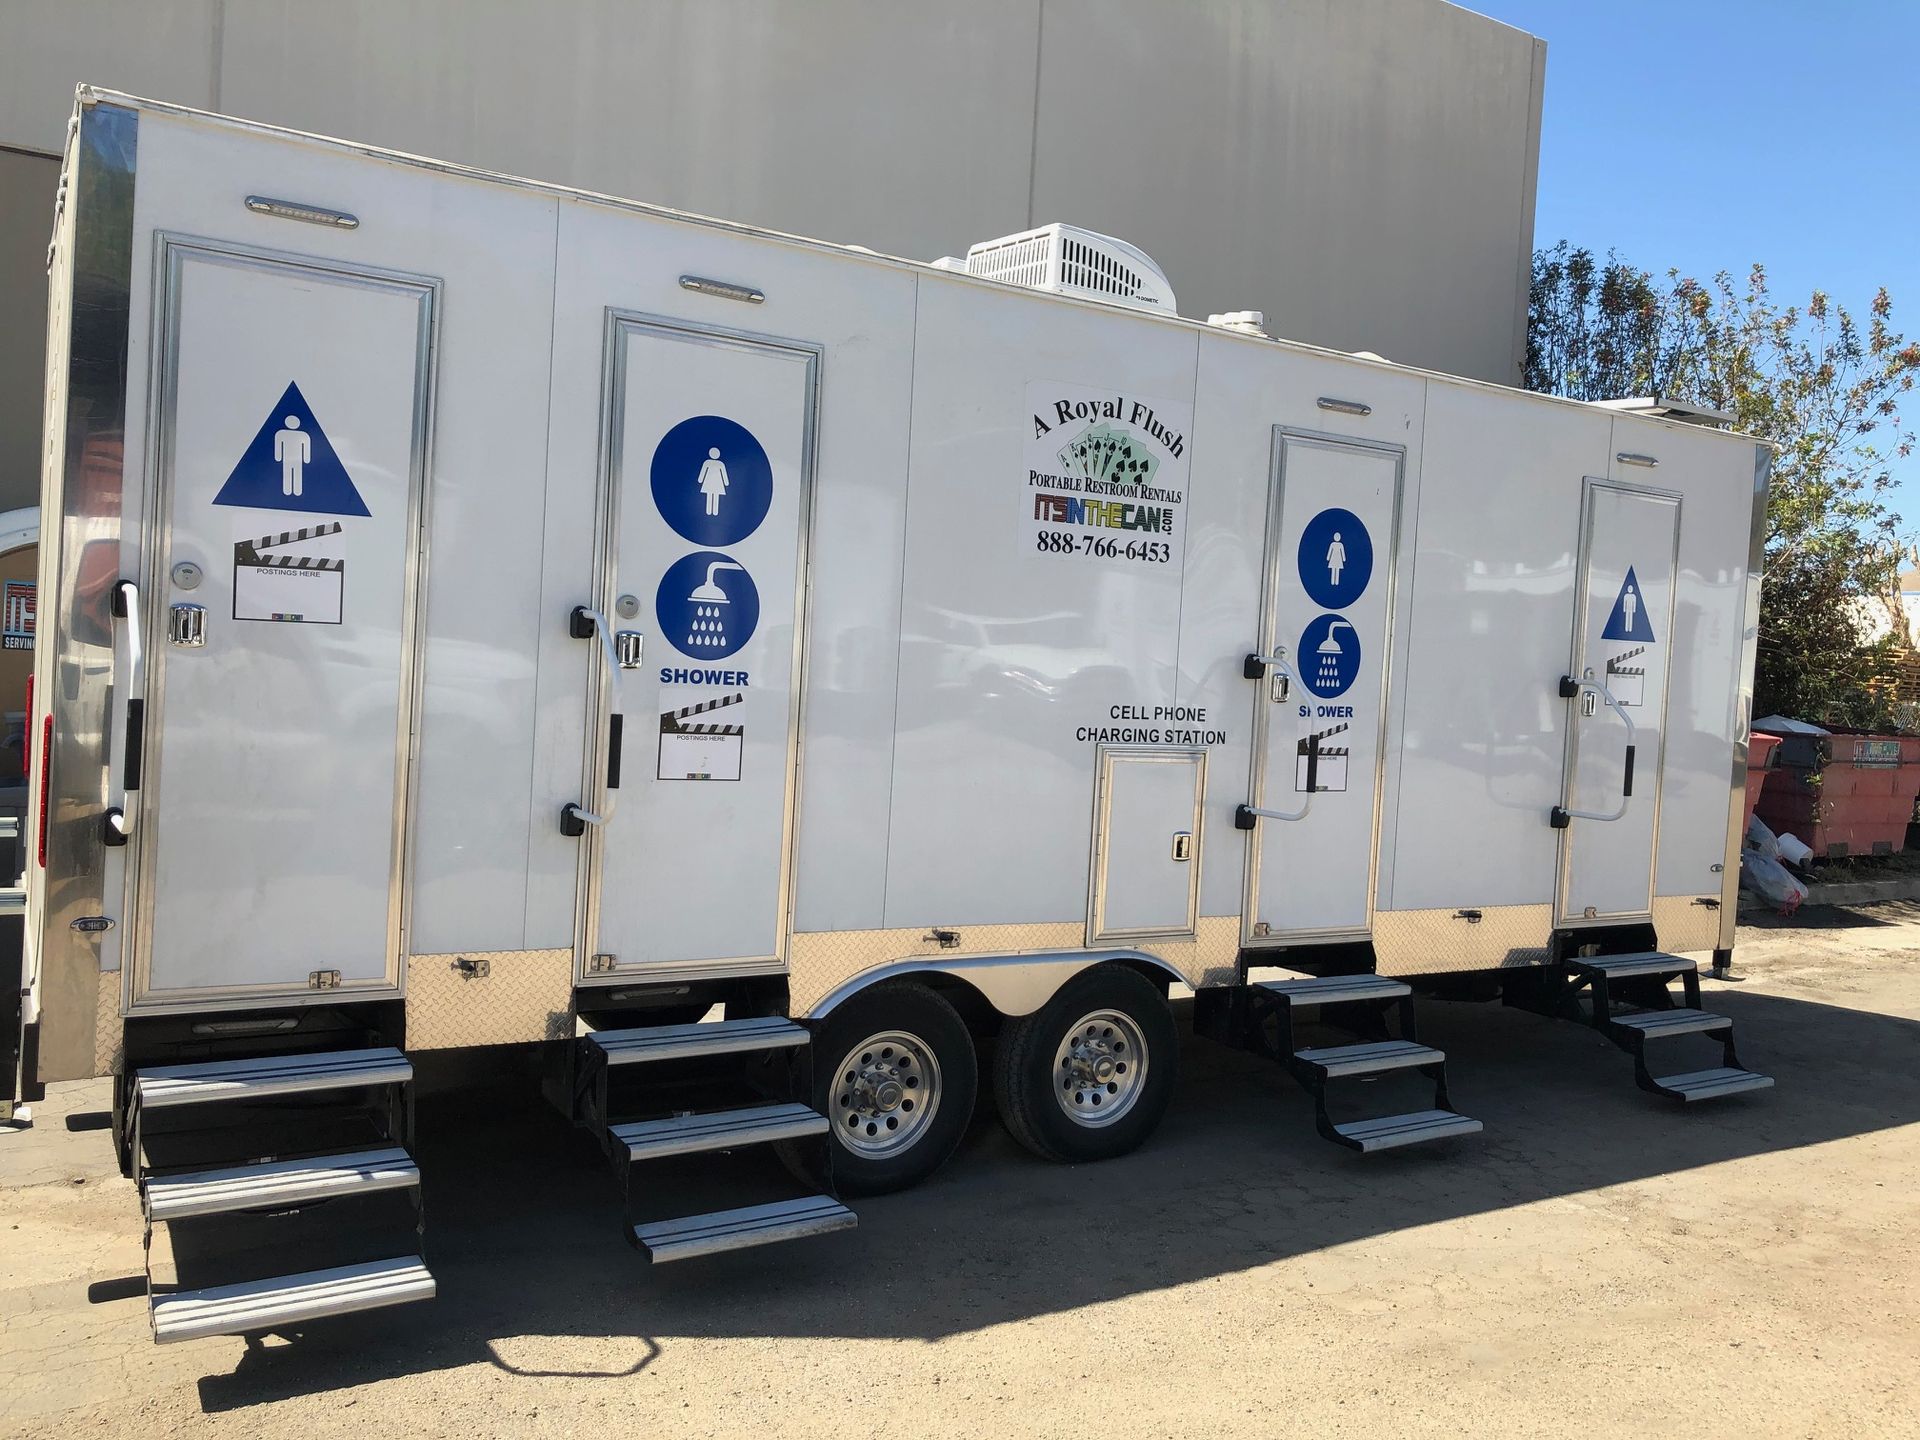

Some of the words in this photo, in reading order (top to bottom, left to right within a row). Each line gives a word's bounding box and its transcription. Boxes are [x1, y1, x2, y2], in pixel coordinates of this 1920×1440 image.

[1033, 413, 1052, 440] A
[1053, 396, 1124, 424] Royal
[1129, 400, 1184, 460] Flush
[1028, 469, 1082, 492] PORTABLE
[1084, 476, 1138, 497] RESTROOM
[1140, 483, 1182, 504] RENTALS
[1036, 530, 1170, 563] 888-766-6453
[256, 568, 298, 577] POSTINGS
[299, 570, 321, 578] HERE
[659, 668, 749, 686] SHOWER
[1110, 705, 1150, 720] CELL
[1154, 706, 1207, 722] PHONE
[1076, 727, 1160, 743] CHARGING
[1164, 729, 1227, 745] STATION
